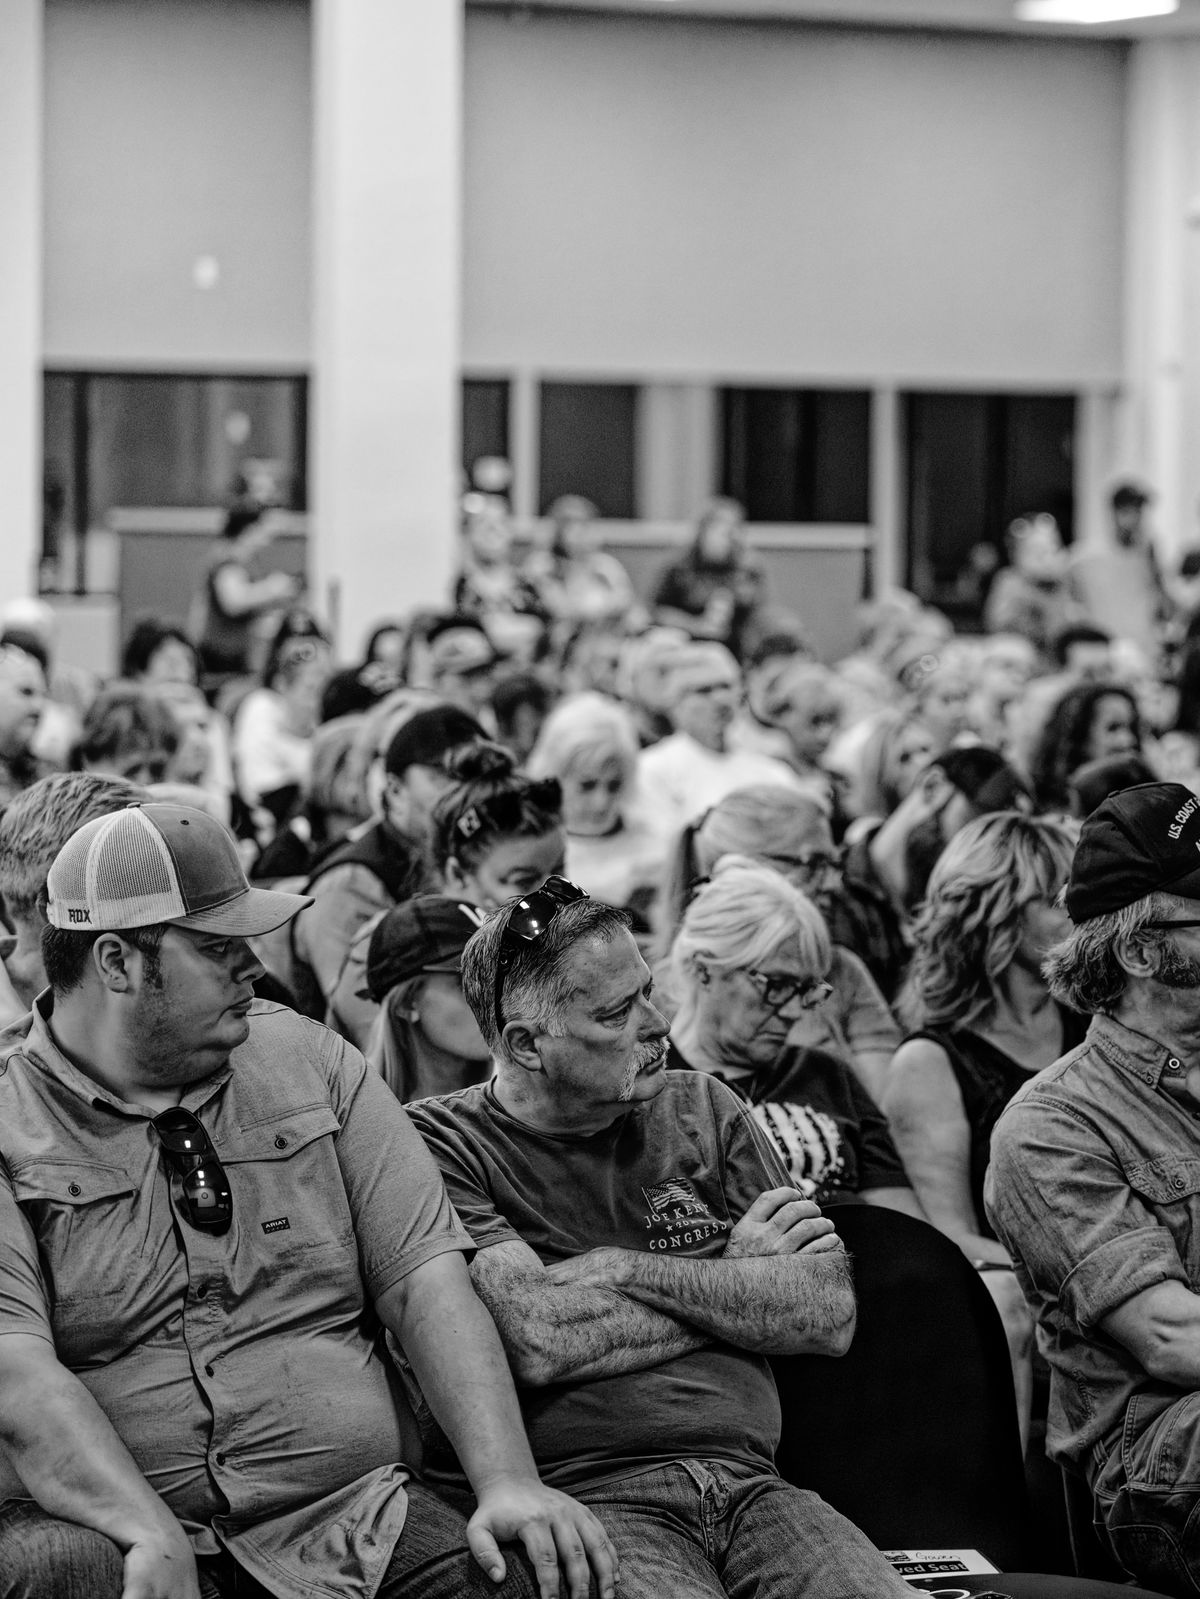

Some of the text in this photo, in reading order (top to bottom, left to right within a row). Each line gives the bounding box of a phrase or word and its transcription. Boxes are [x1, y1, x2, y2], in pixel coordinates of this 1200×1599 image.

[1168, 798, 1198, 839] U.S. COAST
[265, 1219, 287, 1229] ARIAT
[643, 1203, 710, 1228] JOE KENT
[649, 1221, 728, 1250] CONGRESS
[927, 1562, 967, 1572] Seat
